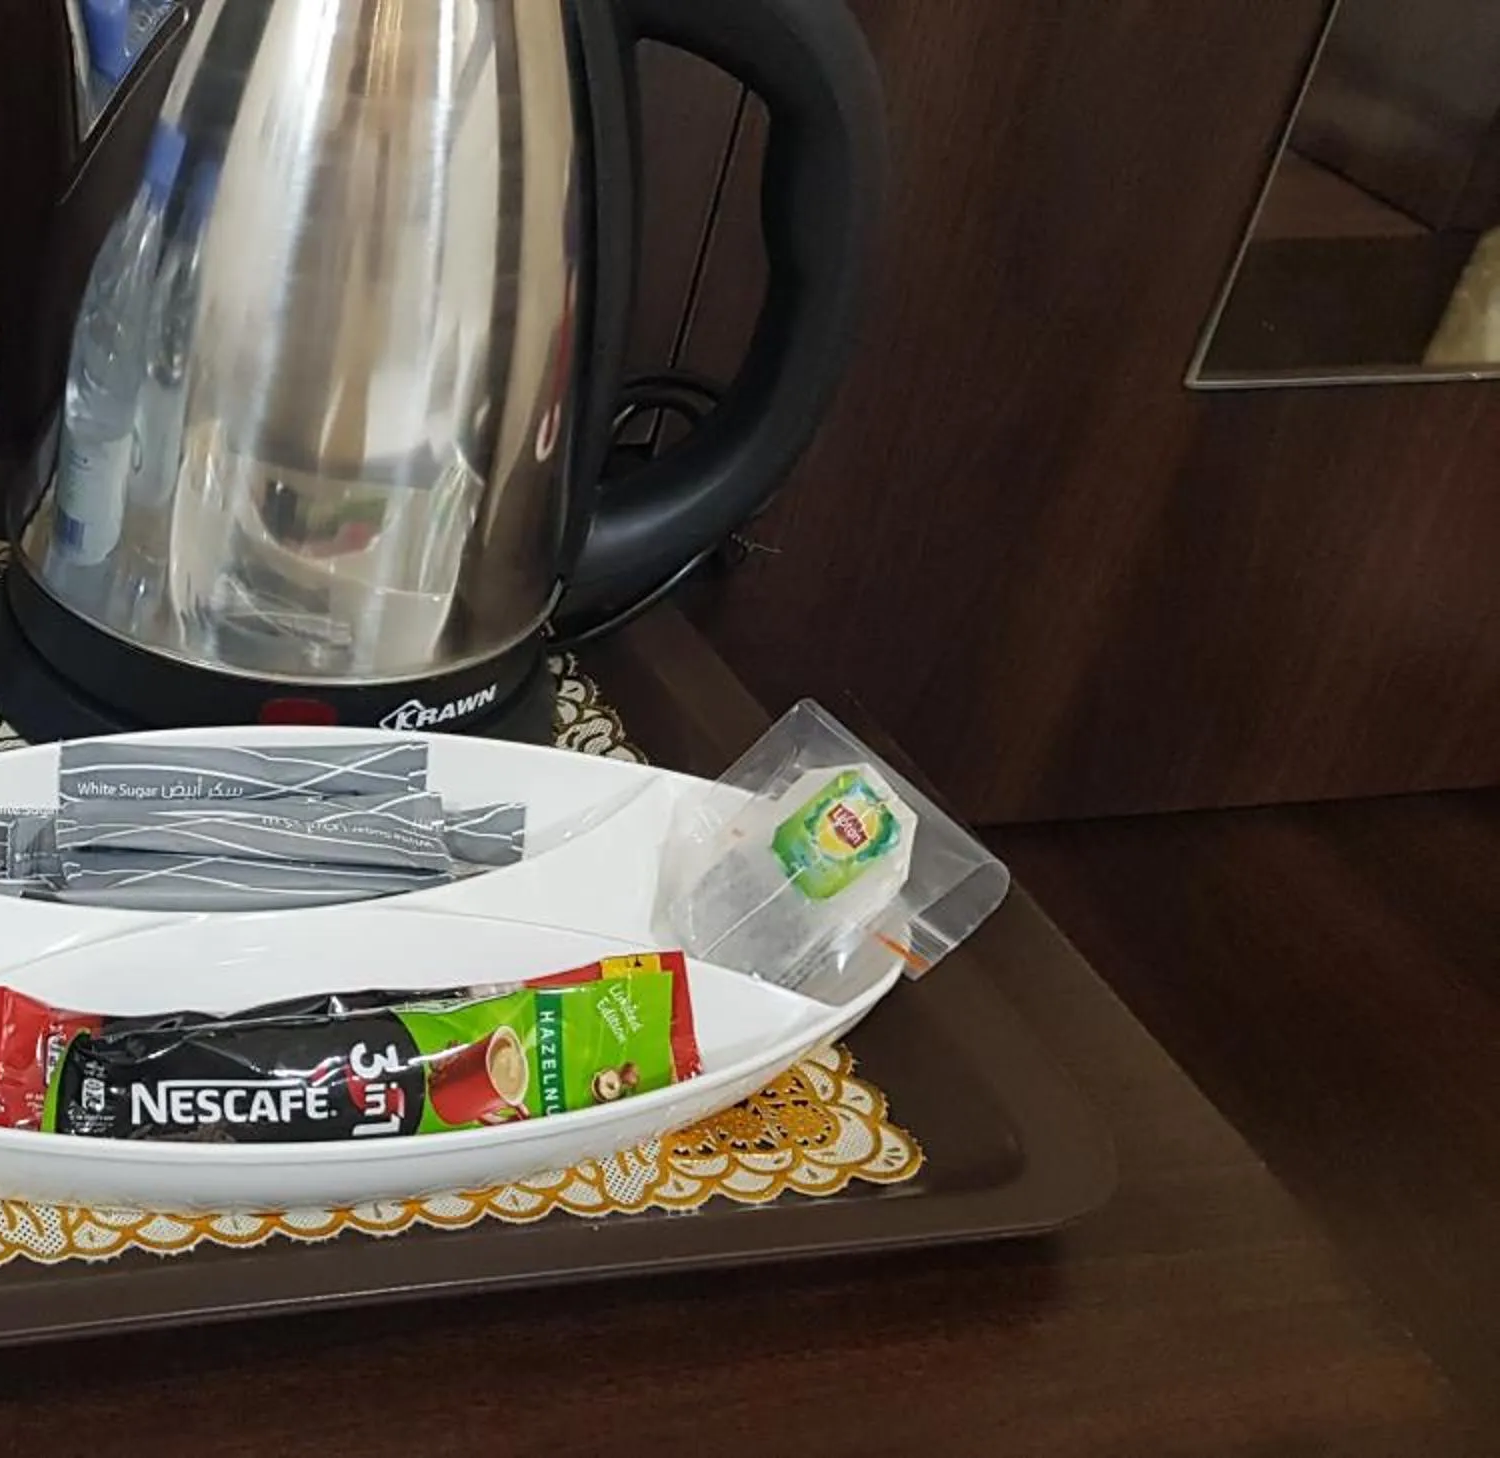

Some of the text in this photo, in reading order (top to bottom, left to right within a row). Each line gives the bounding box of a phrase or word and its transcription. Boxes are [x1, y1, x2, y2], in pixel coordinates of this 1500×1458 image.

[388, 683, 498, 731] KRAWN
[77, 781, 158, 799] White Sugar
[539, 1009, 565, 1118] HAZELNU
